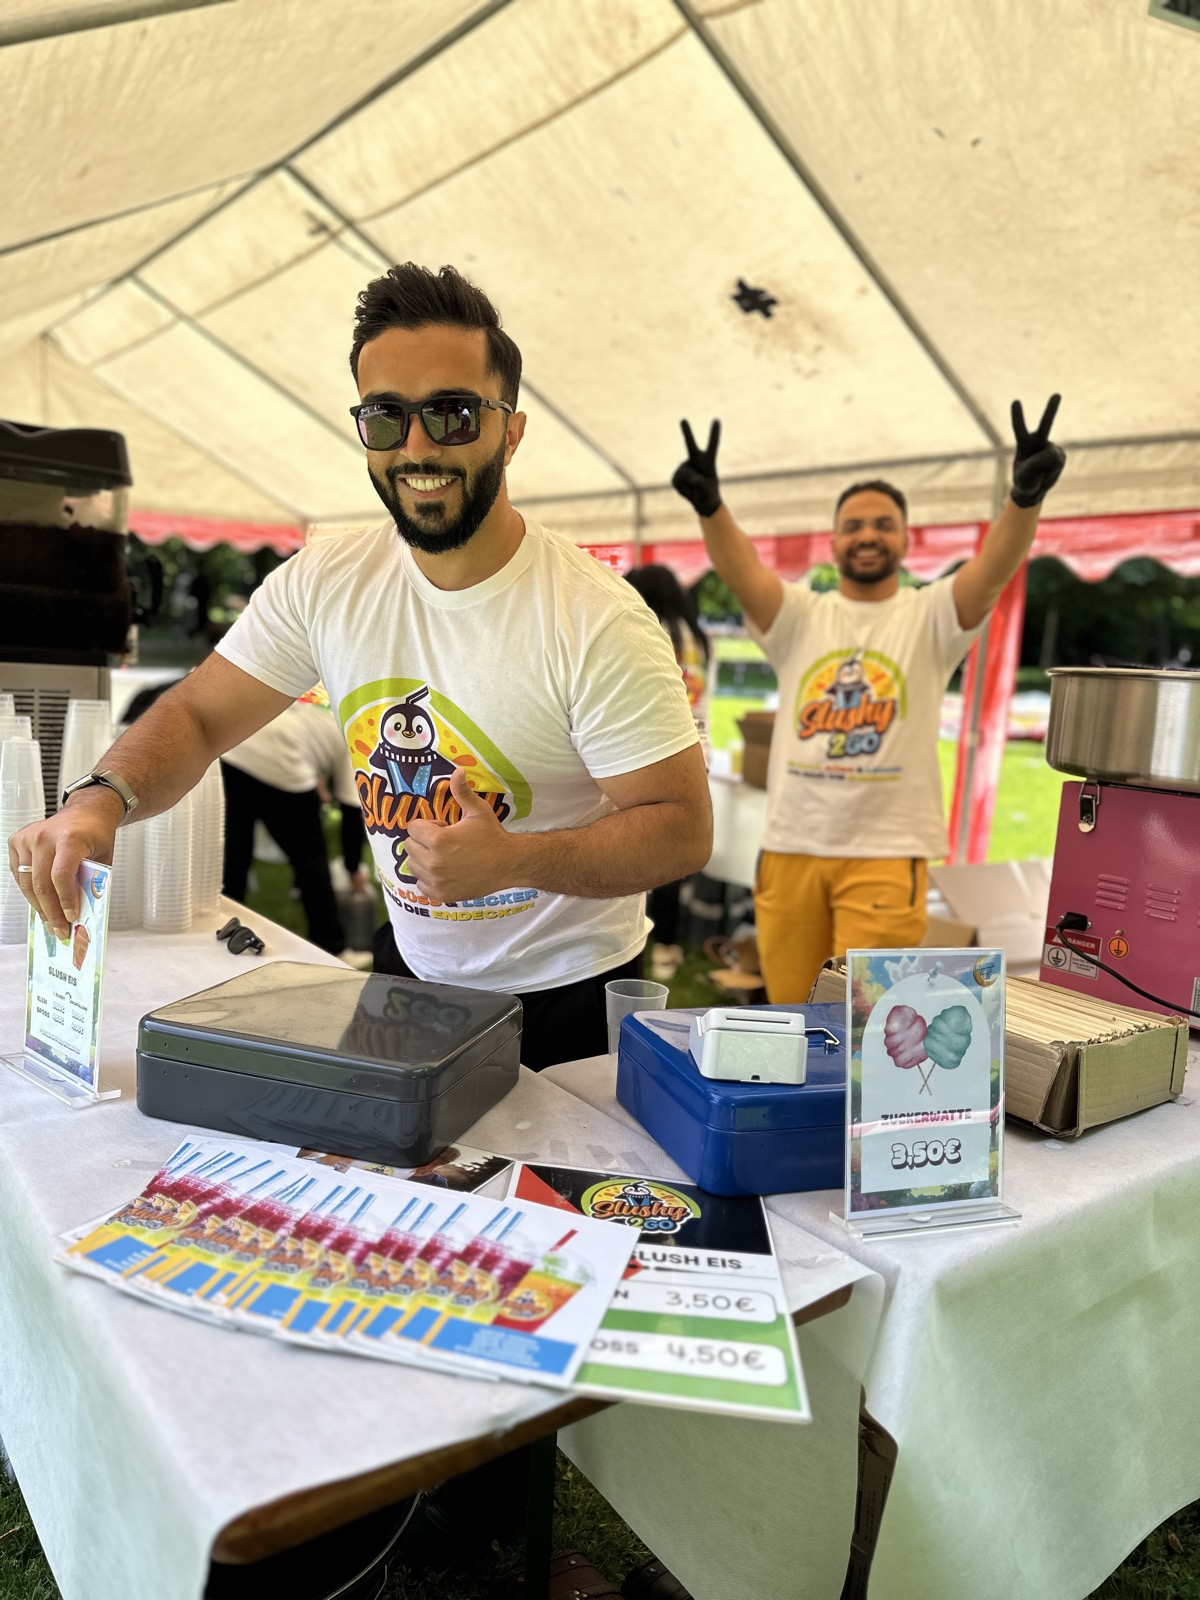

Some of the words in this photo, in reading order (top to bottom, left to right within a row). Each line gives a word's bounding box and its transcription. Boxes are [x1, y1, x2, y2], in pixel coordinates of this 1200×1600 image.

[798, 693, 896, 740] Slushy
[827, 732, 882, 758] 2GO
[355, 772, 508, 832] Slush
[462, 889, 539, 908] LECKER
[404, 902, 431, 918] DIE
[432, 902, 535, 922] ENDECKER
[1067, 937, 1096, 950] DANGER
[48, 966, 67, 982] SLUSH
[67, 974, 77, 987] EIS
[881, 1108, 972, 1126] ZUCKERWATTE
[891, 1137, 962, 1170] 3,50€
[593, 1198, 688, 1221] Slushy
[628, 1217, 675, 1230] 2GO
[707, 1254, 743, 1270] EIS
[665, 1291, 757, 1313] 3,50€
[590, 1338, 639, 1355] OSS
[667, 1341, 766, 1371] 4,50€
